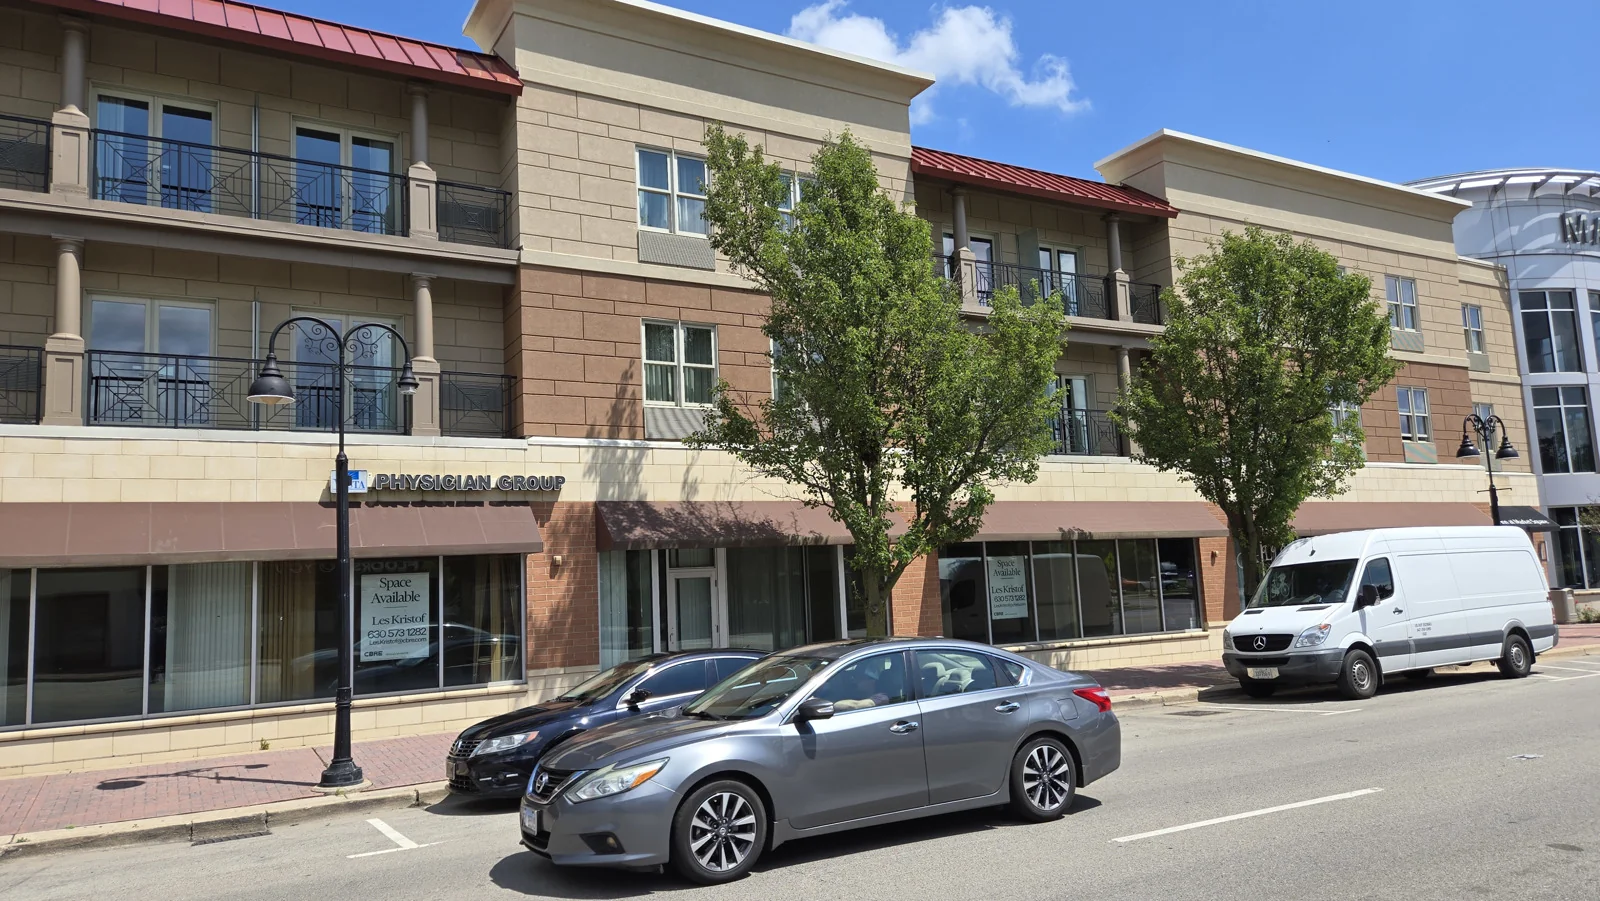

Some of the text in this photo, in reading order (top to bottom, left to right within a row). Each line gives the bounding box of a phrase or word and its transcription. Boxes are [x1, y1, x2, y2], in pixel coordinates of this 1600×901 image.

[376, 473, 491, 490] PHYSICIAN
[498, 475, 566, 491] GROUP
[997, 560, 1015, 568] Space
[993, 568, 1021, 576] Available
[379, 577, 412, 591] Space
[1003, 584, 1024, 594] Kristof
[370, 590, 421, 604] Available
[372, 613, 427, 626] Les Kristof
[367, 627, 427, 639] 630 573 1282
